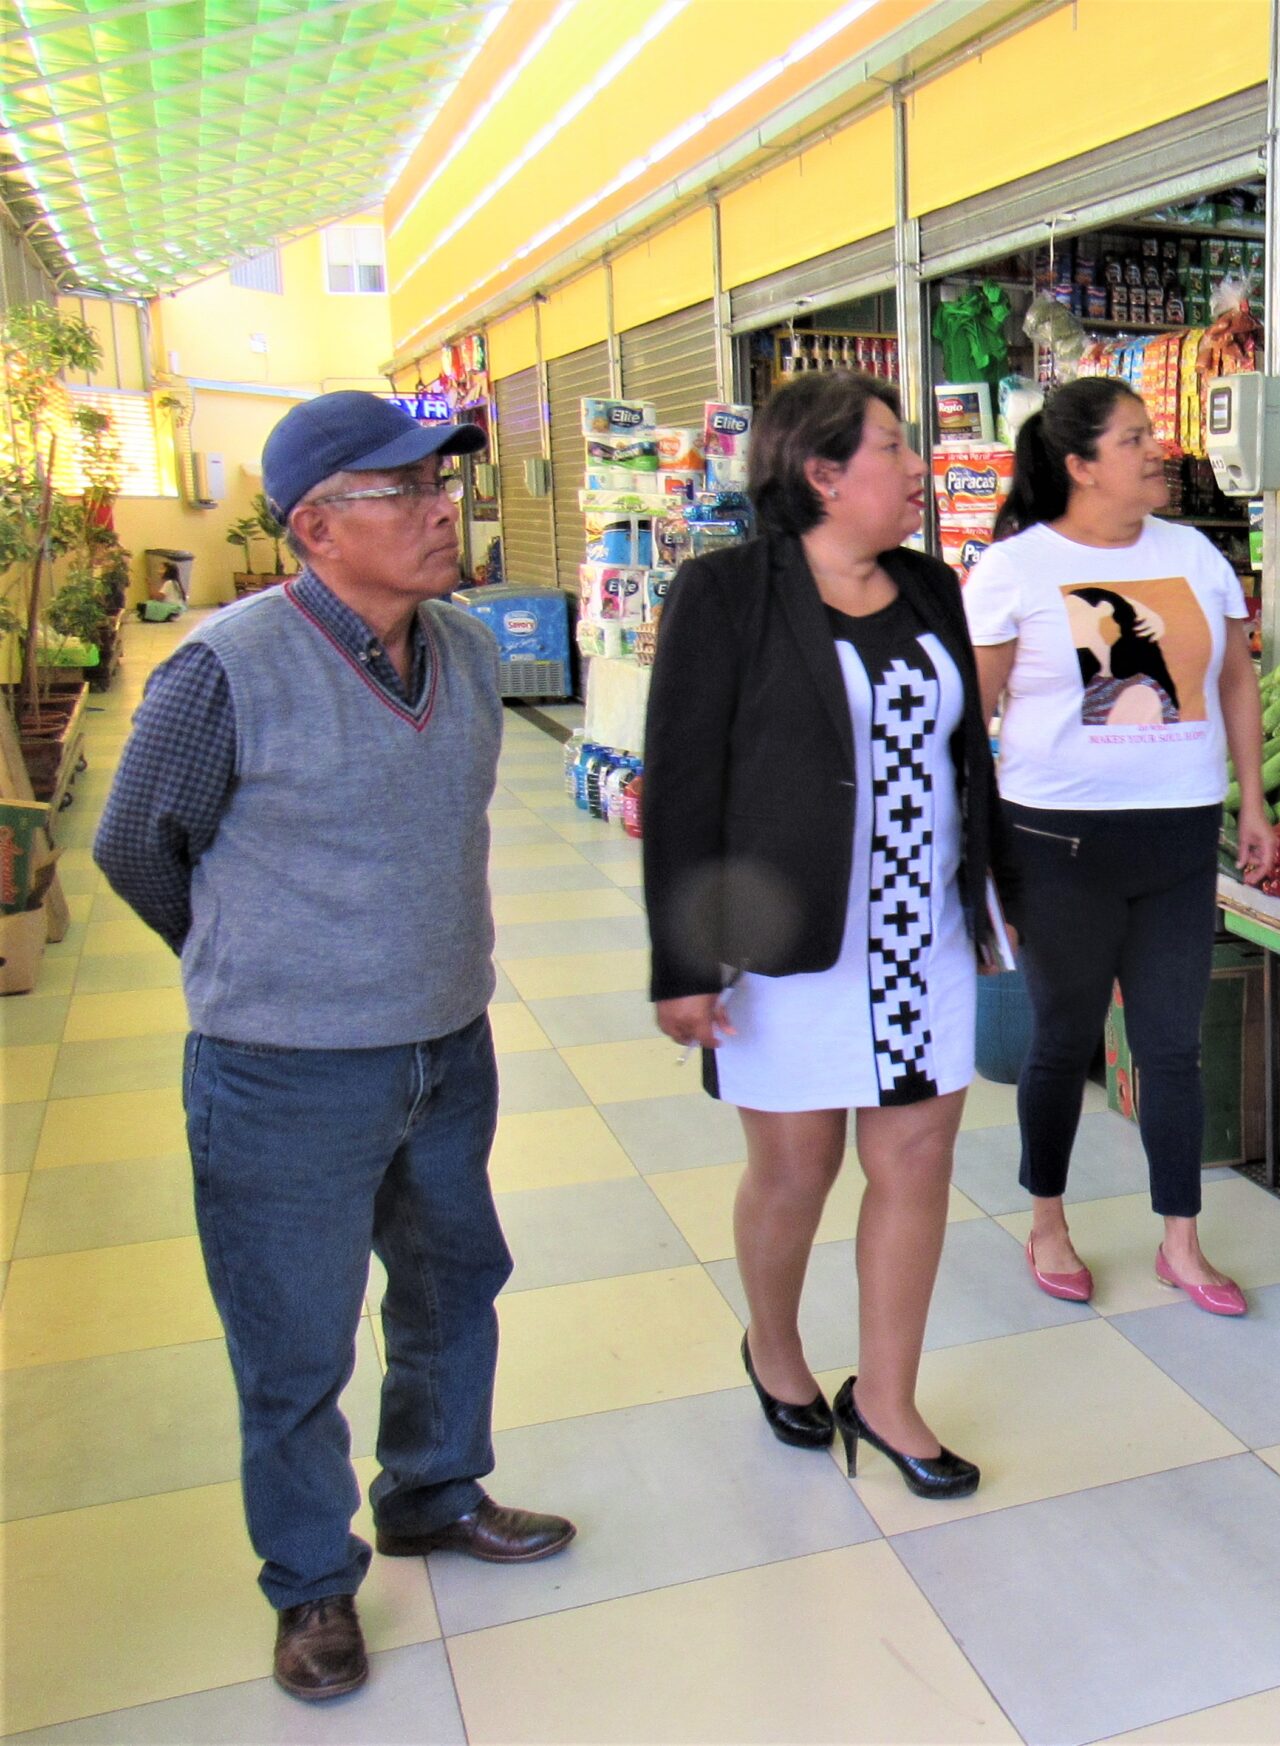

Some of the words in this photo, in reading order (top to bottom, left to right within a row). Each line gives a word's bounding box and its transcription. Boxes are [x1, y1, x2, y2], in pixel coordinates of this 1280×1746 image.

[611, 410, 641, 424] Elite
[713, 415, 746, 430] Elite
[948, 471, 995, 491] Paracas
